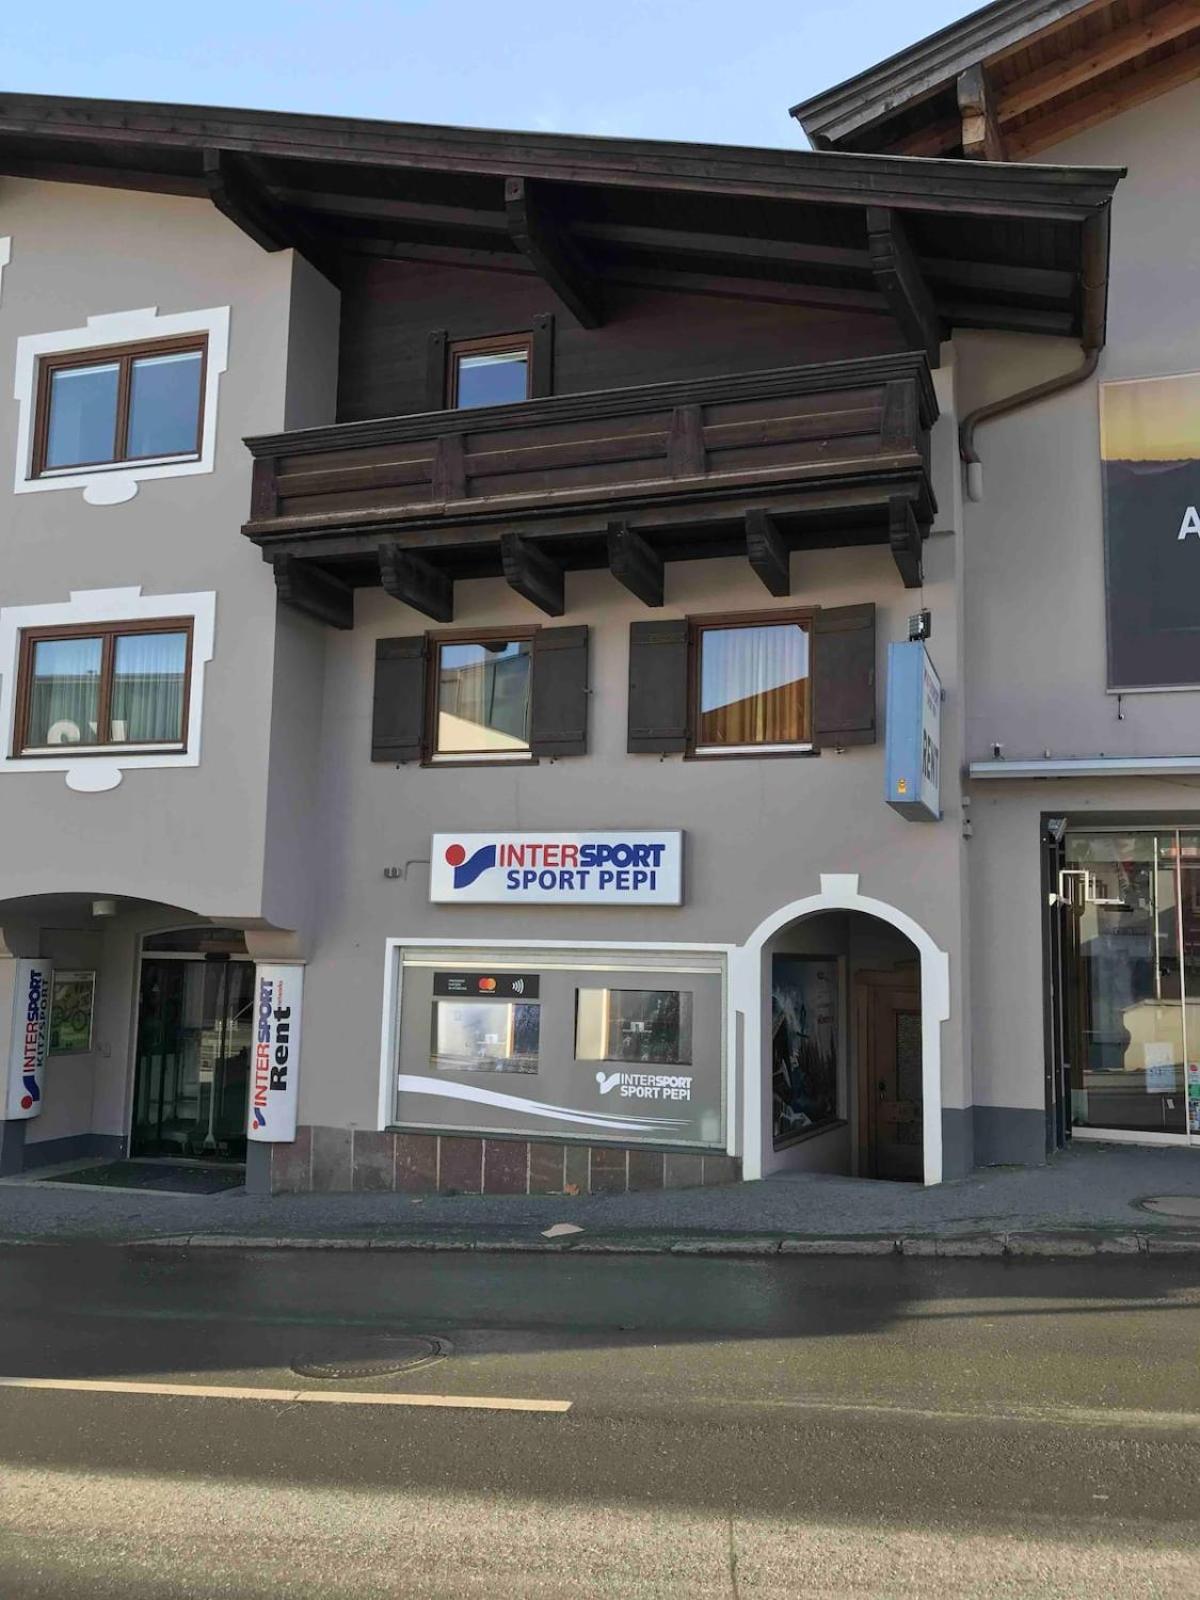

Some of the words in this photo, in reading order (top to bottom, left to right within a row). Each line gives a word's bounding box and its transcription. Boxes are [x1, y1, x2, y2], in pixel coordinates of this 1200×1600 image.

[499, 843, 666, 868] INTERSPORT
[506, 869, 590, 891] SPORT
[599, 869, 657, 891] PEPI
[22, 969, 43, 1073] INTERSPORT
[36, 978, 49, 1067] KITZSPORT
[254, 977, 274, 1108] INTERSPORT
[270, 1005, 291, 1091] Rent
[620, 1085, 661, 1099] SPORT
[662, 1087, 691, 1101] PEPI
[621, 1073, 693, 1089] INTERSPORT
